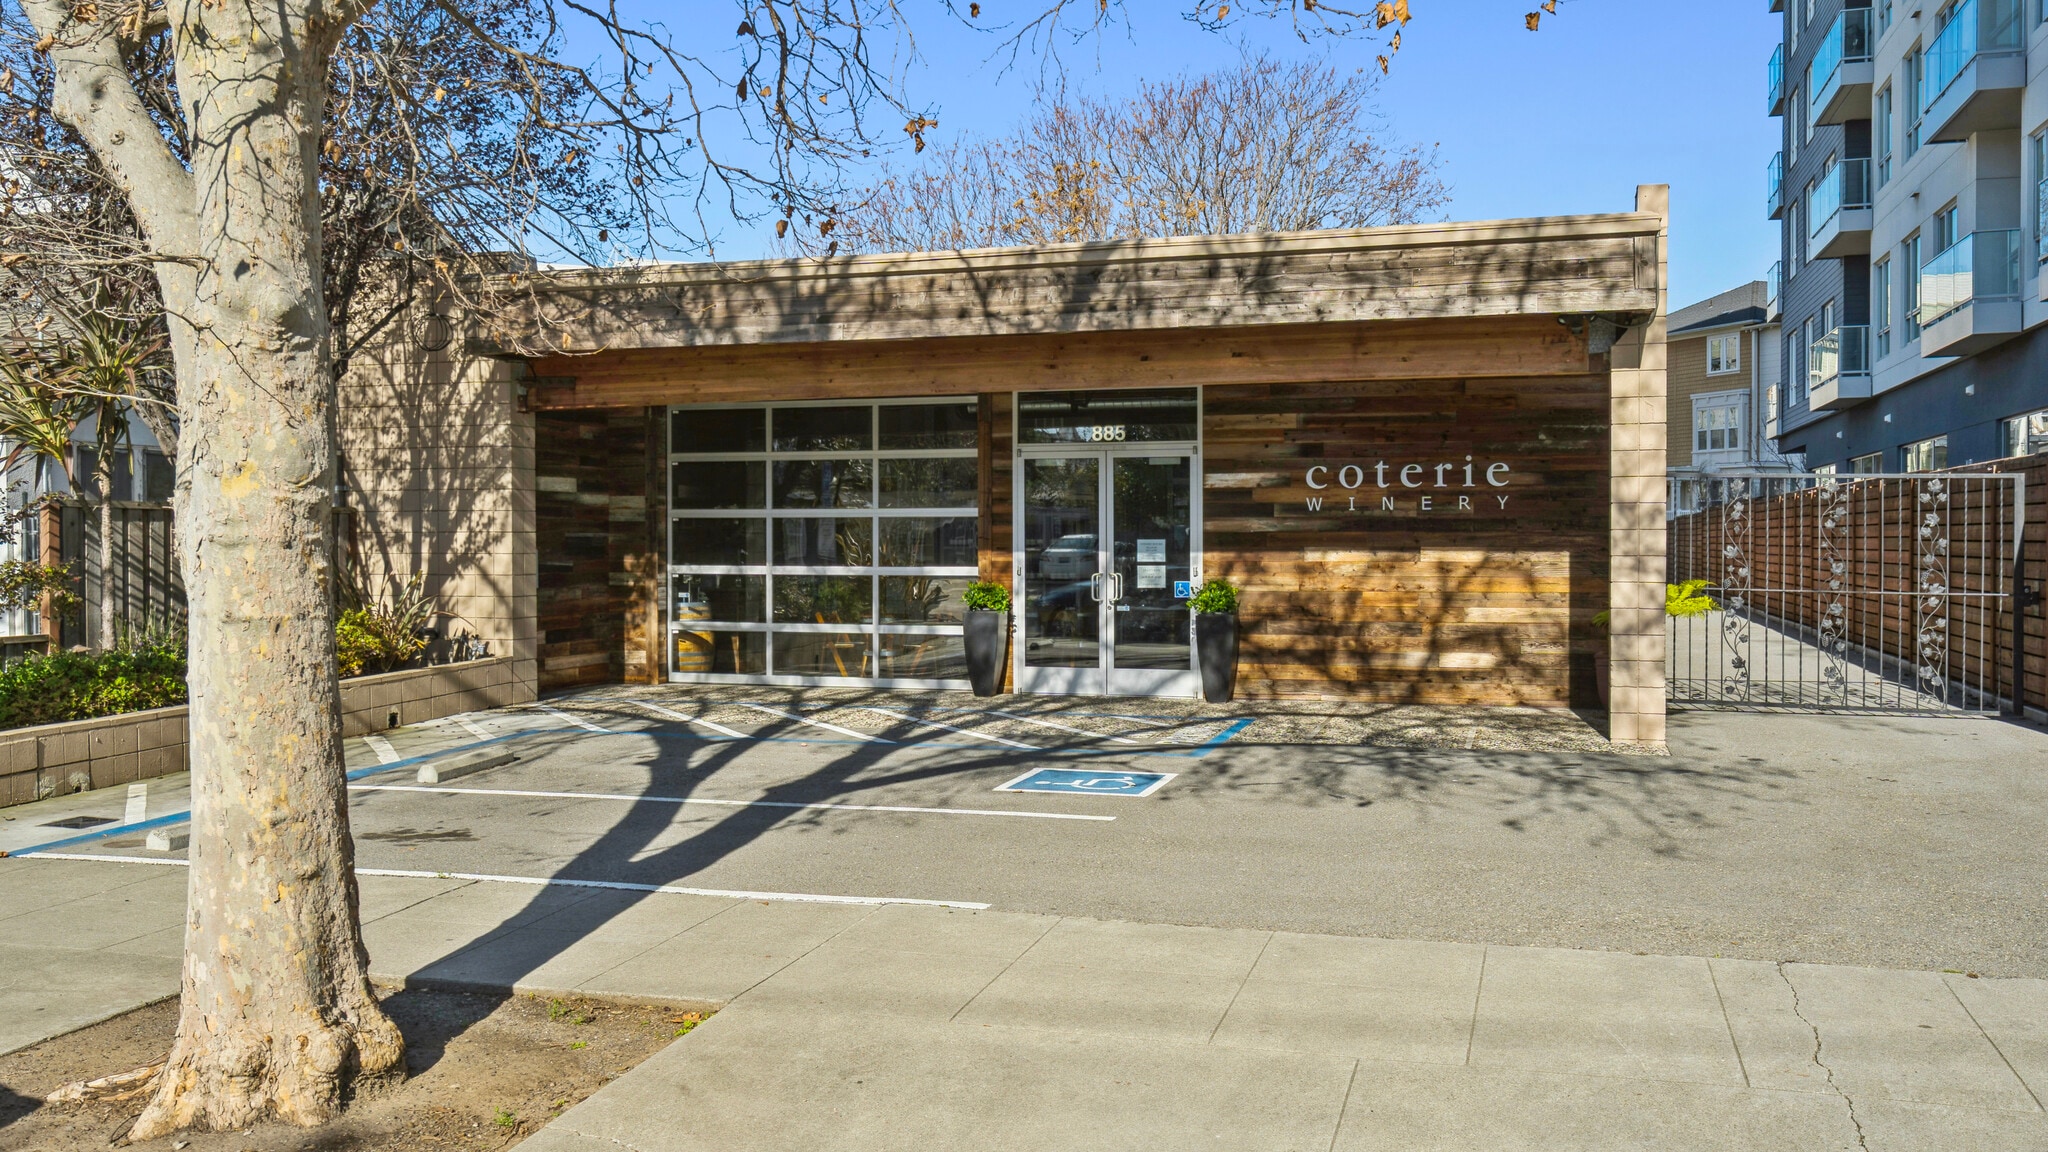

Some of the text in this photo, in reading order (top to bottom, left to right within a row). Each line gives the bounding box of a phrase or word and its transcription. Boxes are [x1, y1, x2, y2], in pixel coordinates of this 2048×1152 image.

[1092, 425, 1126, 441] 885
[1305, 455, 1510, 489] coterie
[1306, 496, 1509, 511] WINERY
